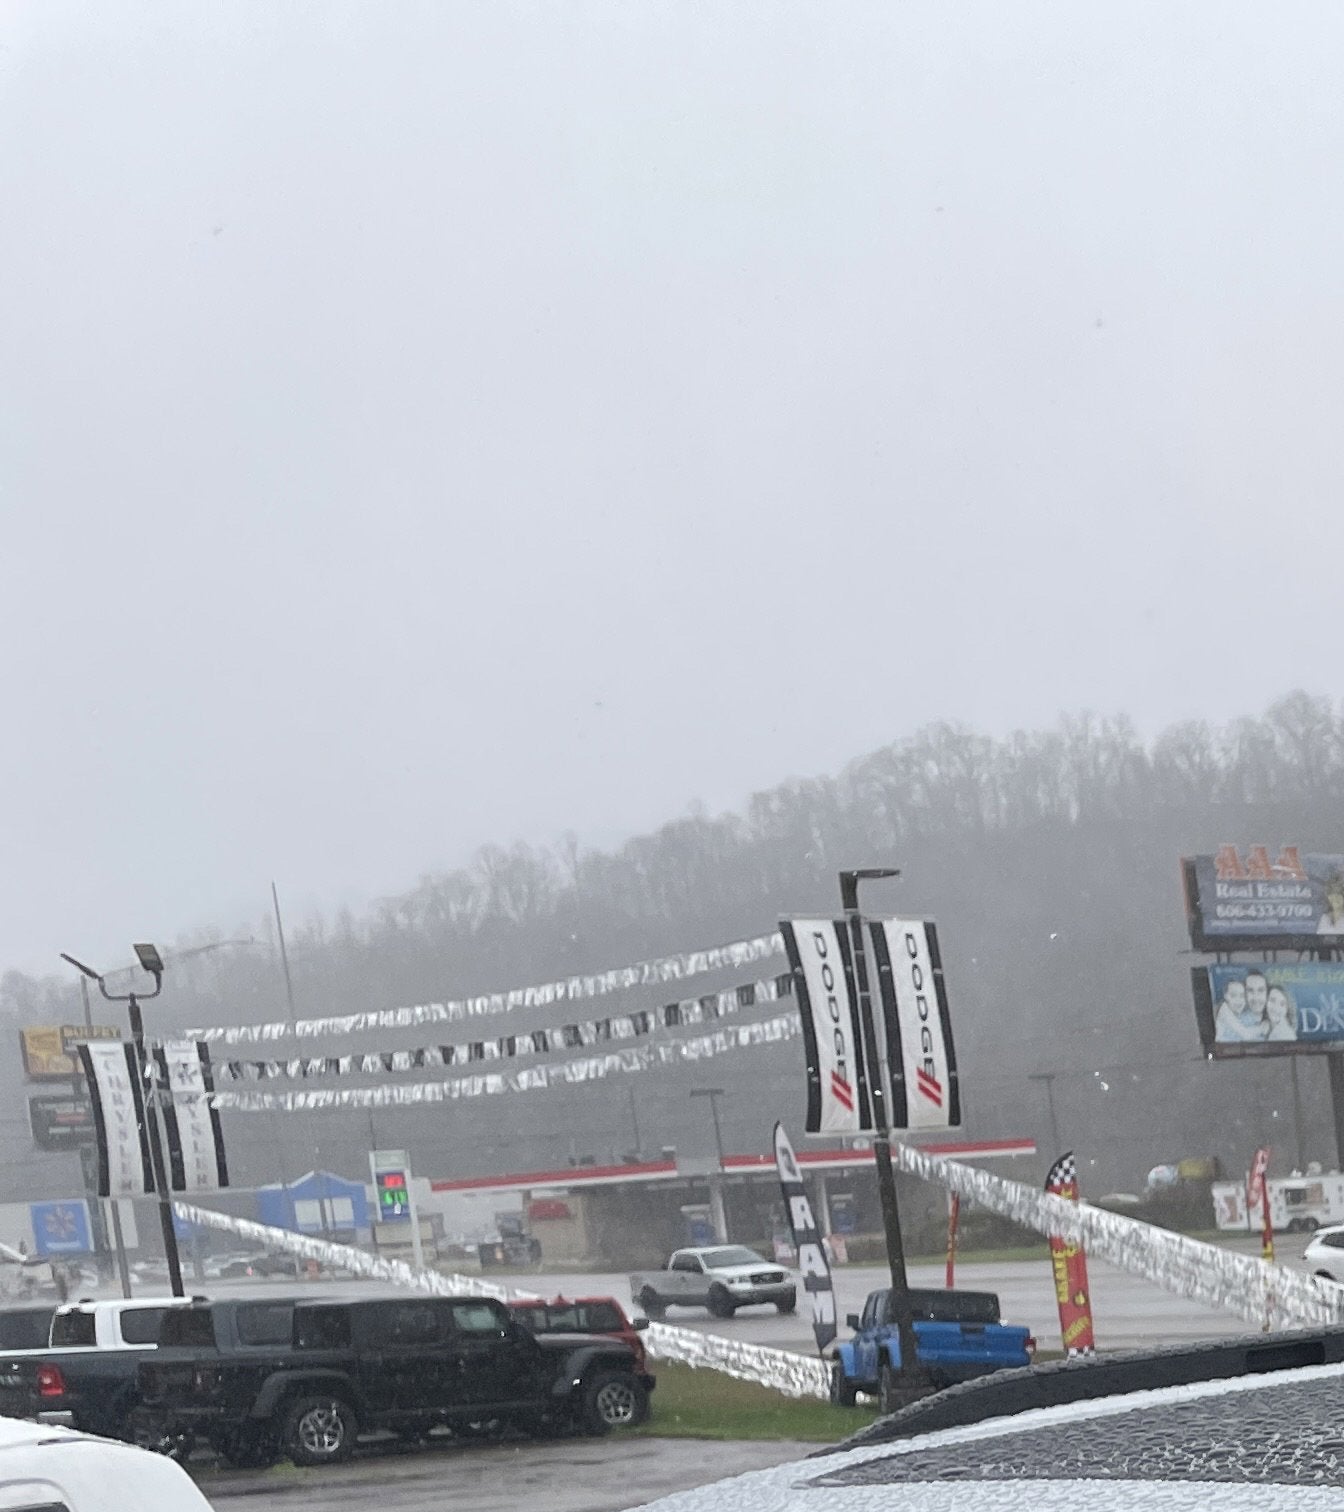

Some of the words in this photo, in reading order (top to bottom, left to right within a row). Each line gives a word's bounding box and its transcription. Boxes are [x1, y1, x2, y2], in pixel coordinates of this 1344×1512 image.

[1214, 843, 1309, 880] AAA
[1215, 883, 1253, 898] Real
[1257, 884, 1312, 899] Estate
[813, 931, 848, 1085] DODGE
[906, 933, 936, 1084] DODGE
[789, 1195, 837, 1326] RAM
